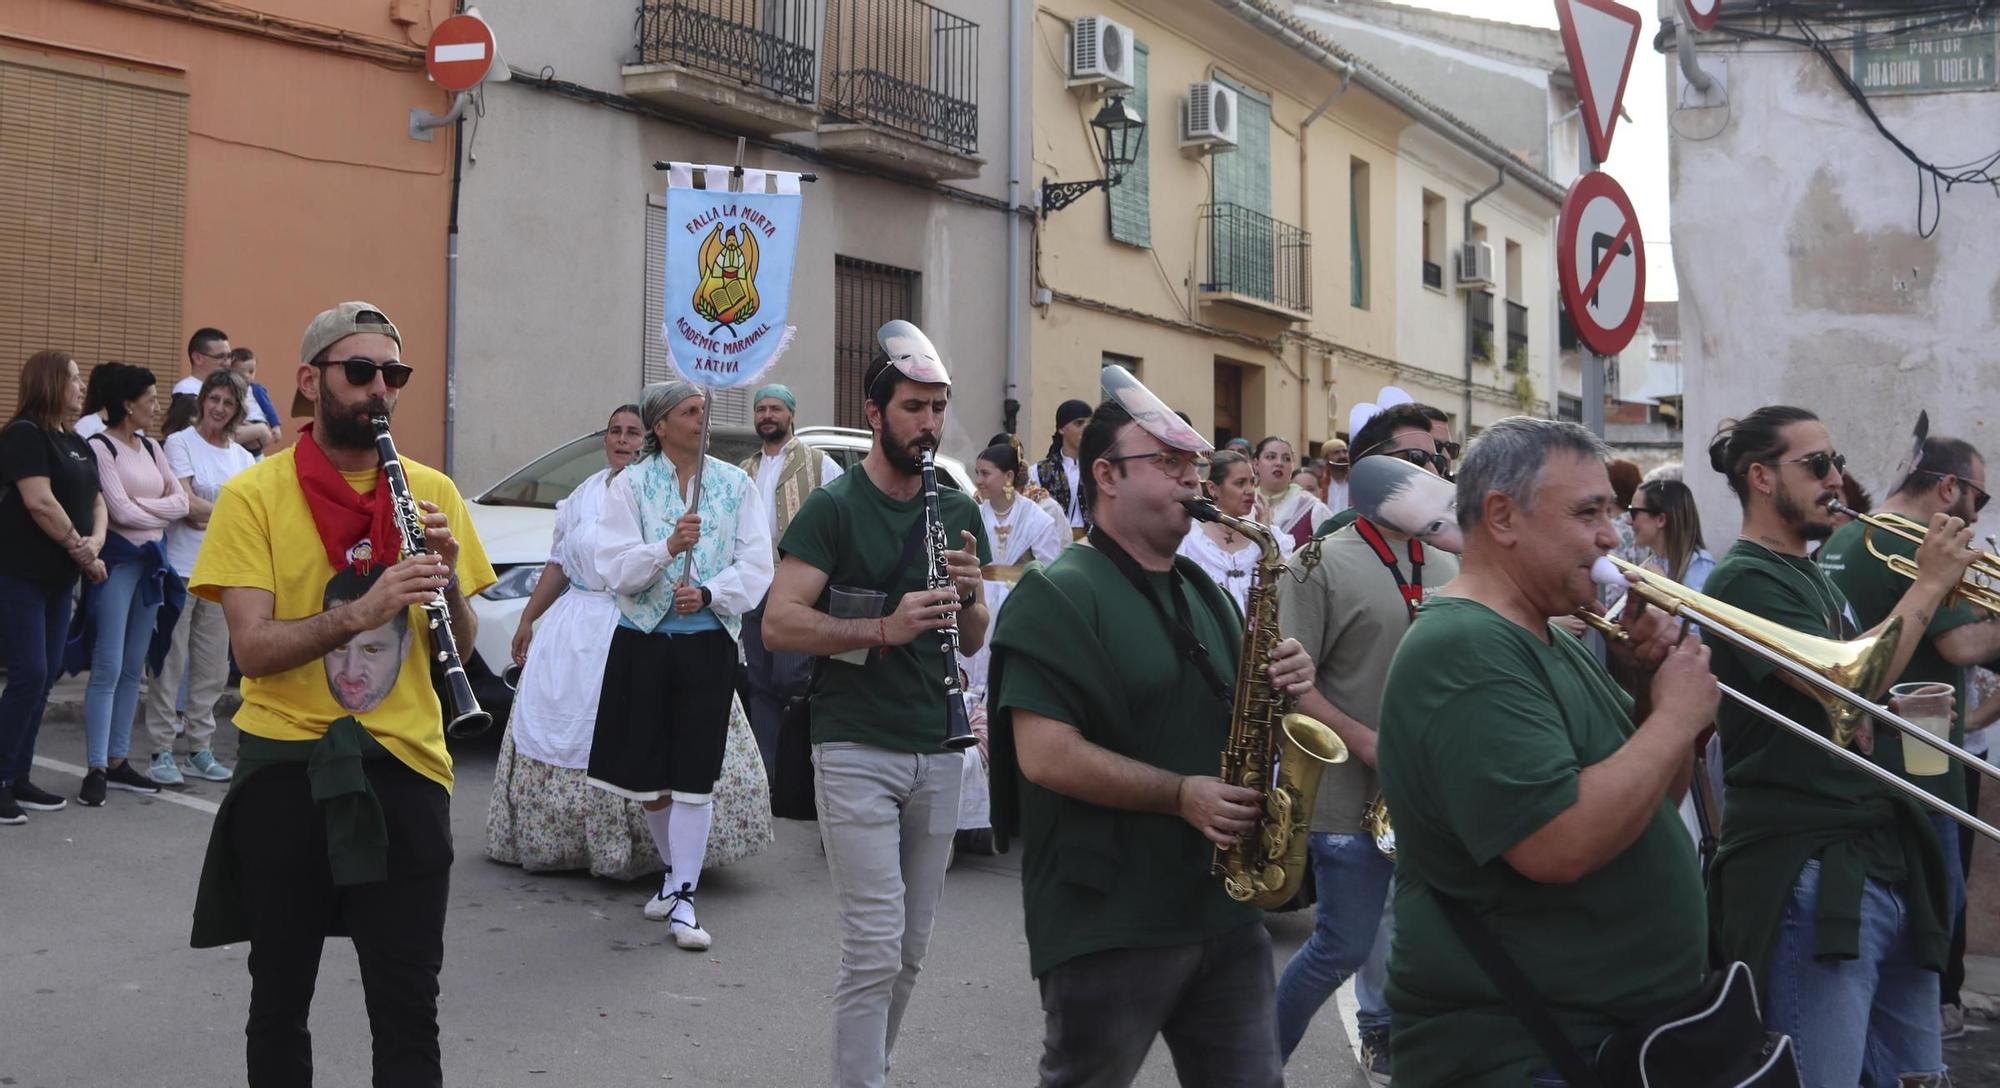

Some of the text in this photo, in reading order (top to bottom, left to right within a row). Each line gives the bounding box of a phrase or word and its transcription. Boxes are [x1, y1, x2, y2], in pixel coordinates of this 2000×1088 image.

[1864, 56, 1985, 87] JOAQUIN TUDELA
[686, 204, 776, 238] FALLA LA MURTA
[676, 316, 771, 354] ACADÈMIC MARAVALL
[695, 356, 739, 372] XÀTIVA
